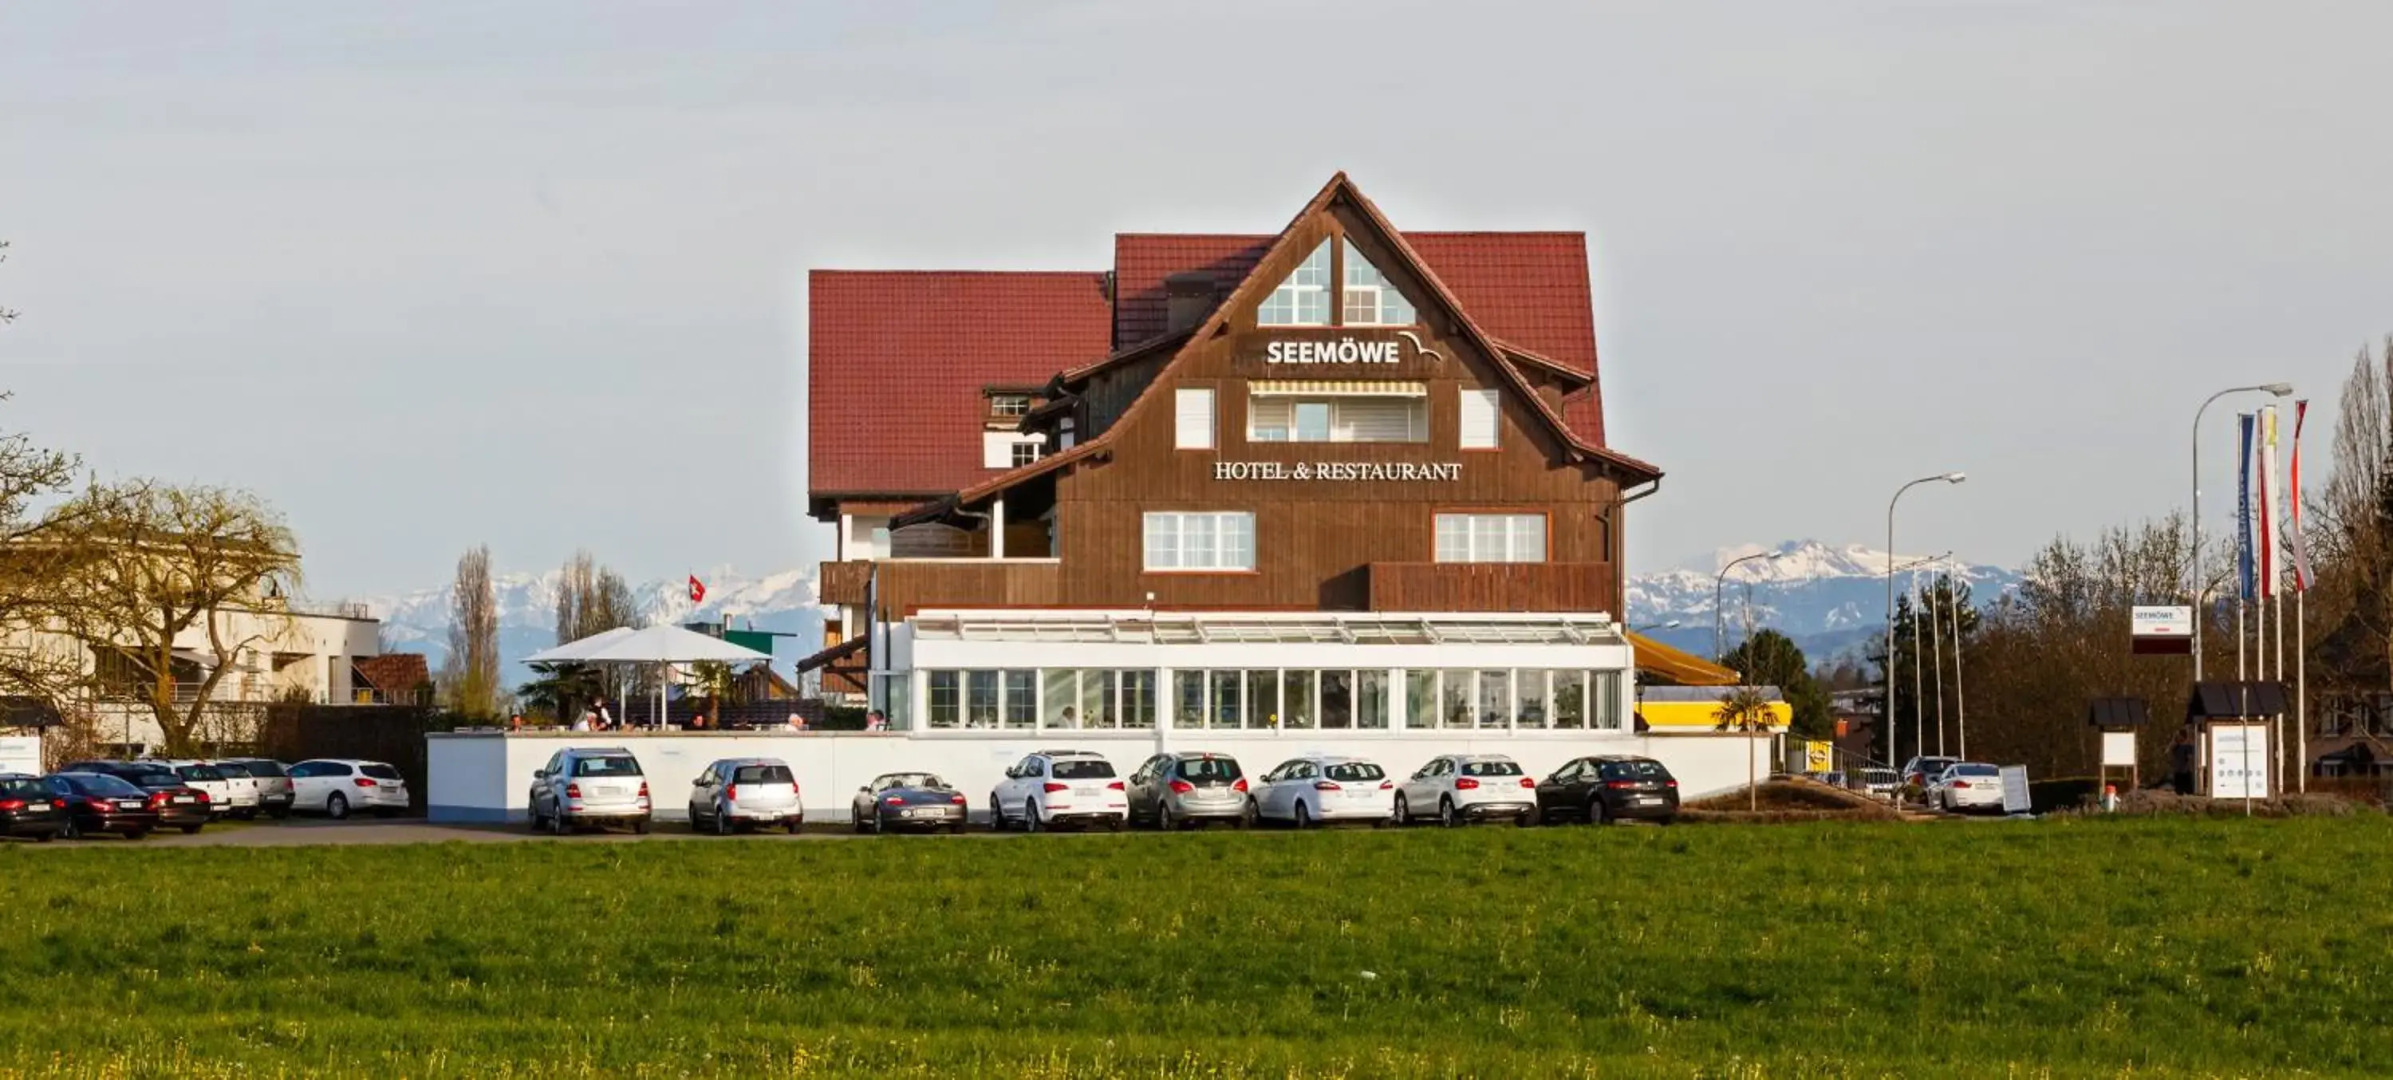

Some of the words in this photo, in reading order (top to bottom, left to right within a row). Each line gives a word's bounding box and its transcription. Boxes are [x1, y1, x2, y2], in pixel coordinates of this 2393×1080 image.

[1267, 338, 1400, 363] SEEMÖWE
[1215, 462, 1290, 480] HOTEL
[1293, 463, 1310, 480] &
[1316, 463, 1463, 480] RESTAURANT
